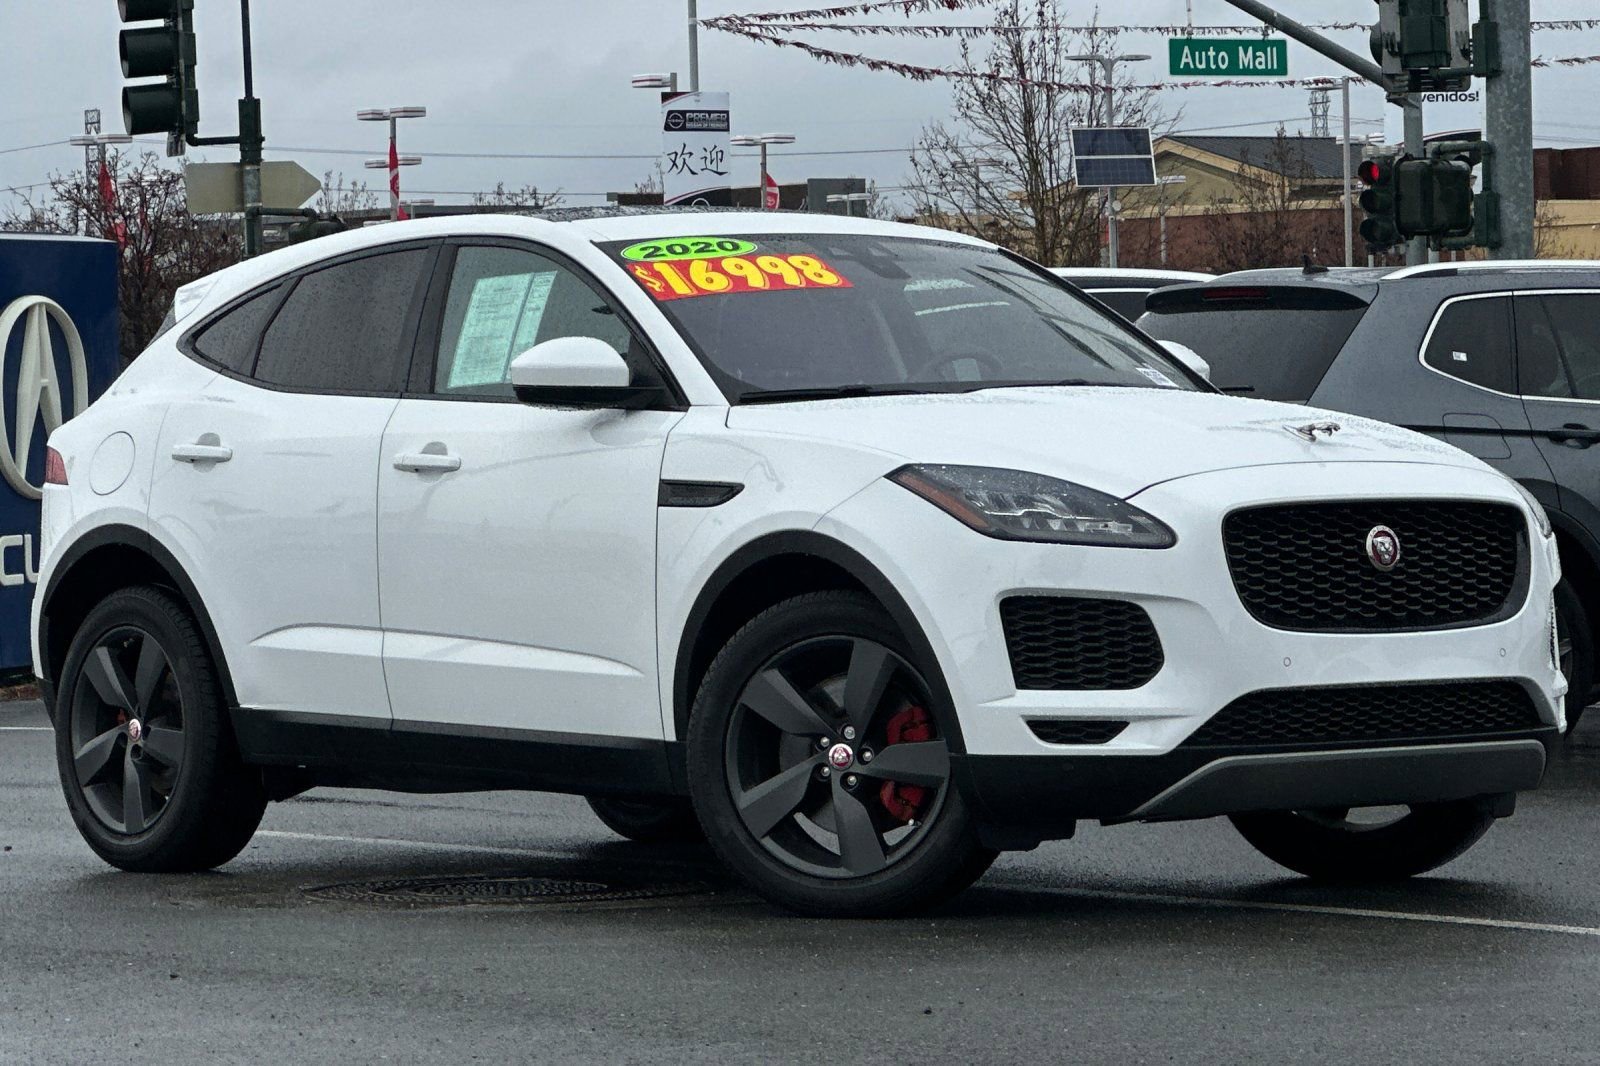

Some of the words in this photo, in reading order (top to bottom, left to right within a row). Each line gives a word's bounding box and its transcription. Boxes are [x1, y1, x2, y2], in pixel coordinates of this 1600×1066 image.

[1180, 45, 1229, 70] Auto
[1238, 46, 1278, 70] Mall
[666, 142, 729, 176] 欢迎
[639, 240, 742, 259] 2020
[634, 255, 843, 295] $16998
